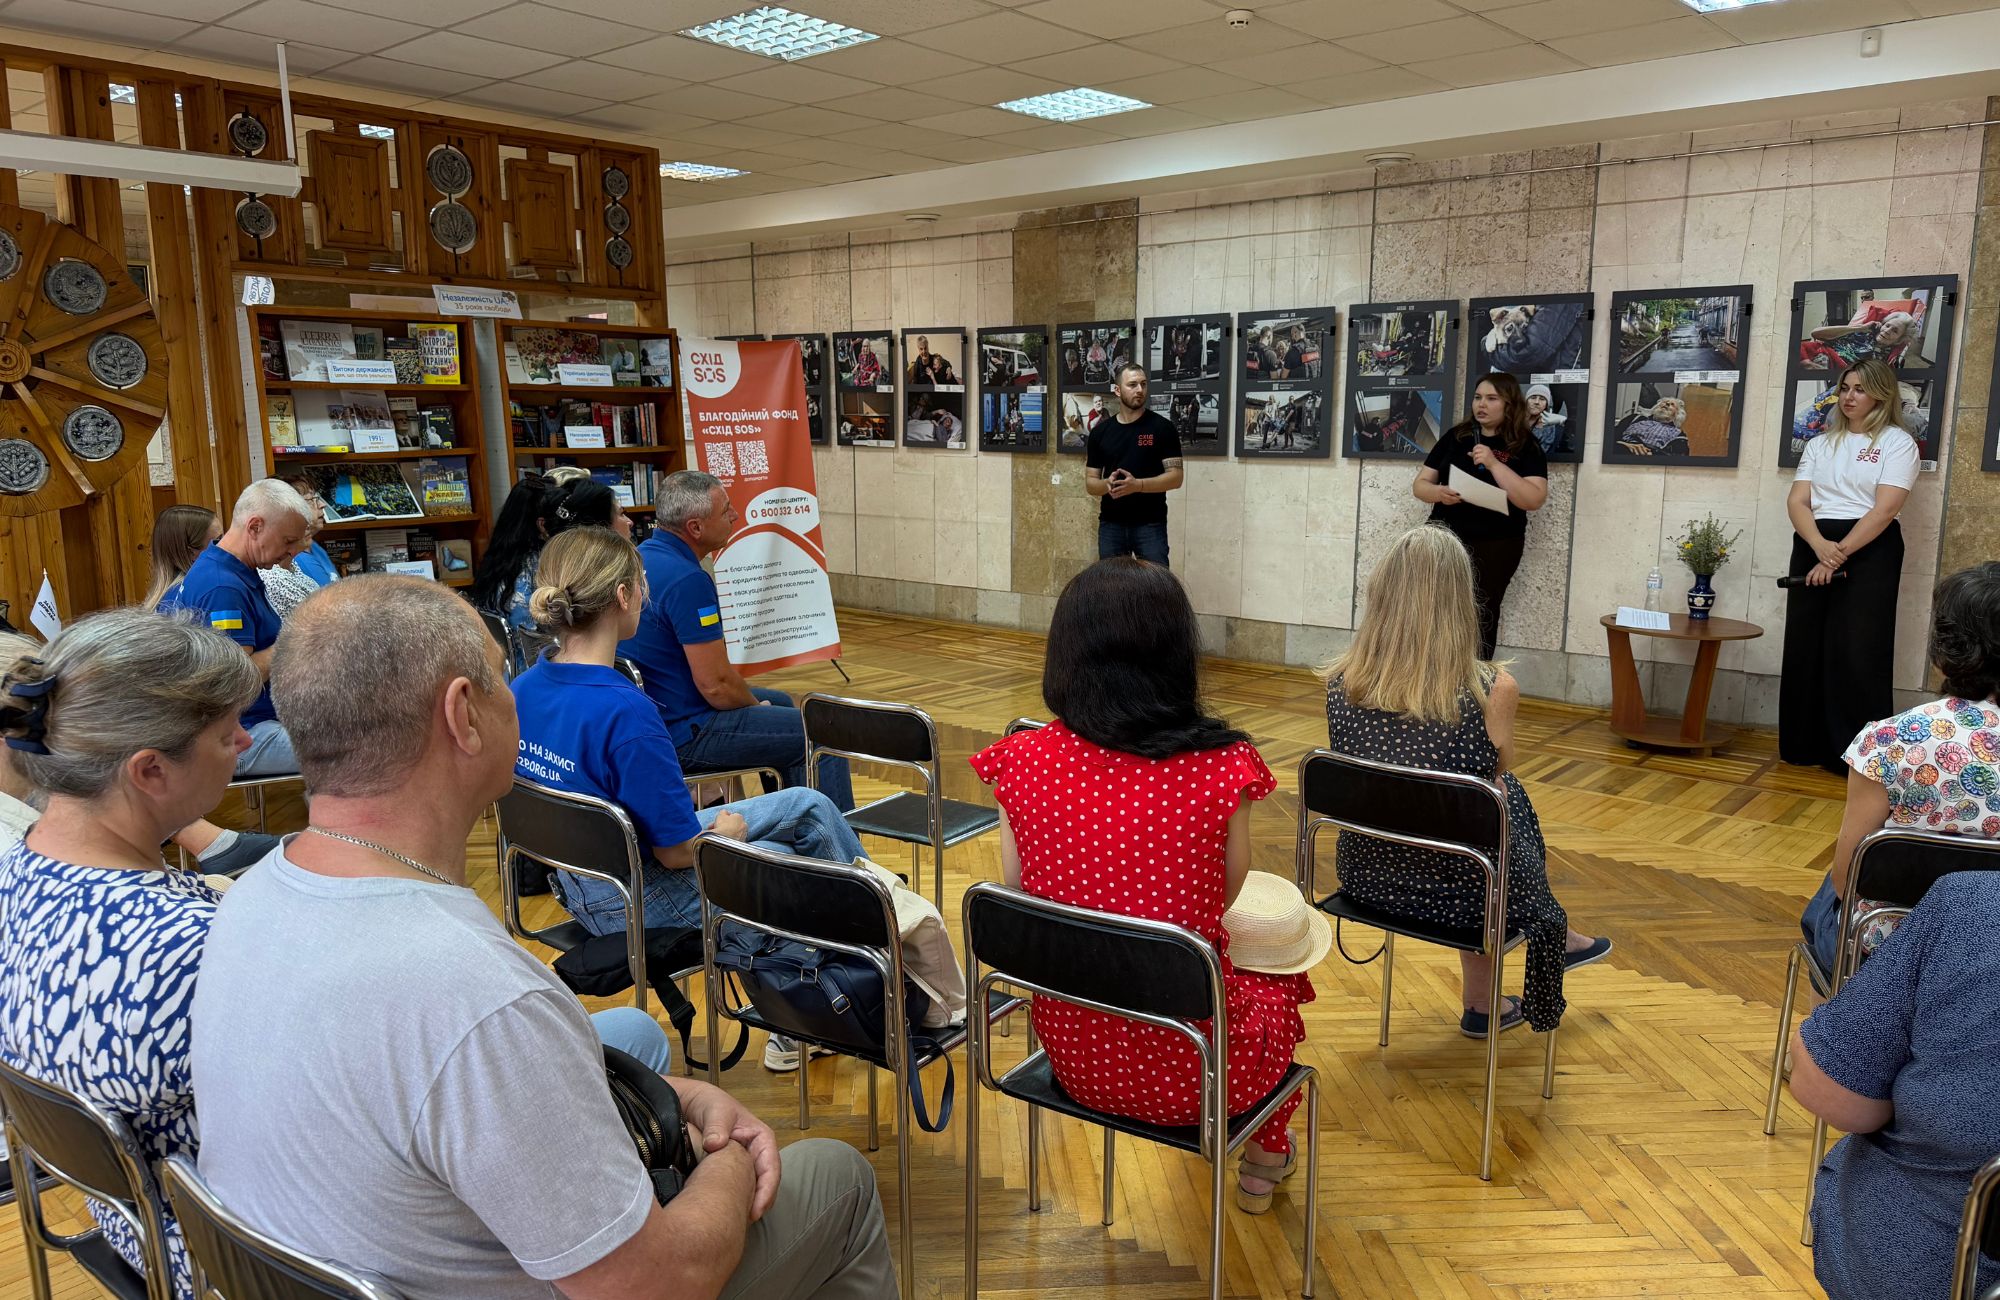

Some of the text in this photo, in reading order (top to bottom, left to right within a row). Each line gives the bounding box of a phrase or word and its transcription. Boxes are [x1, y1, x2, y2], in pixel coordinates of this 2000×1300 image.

[442, 294, 492, 304] Незалежність
[420, 348, 458, 356] ЗАЛЕЖНОСТІ
[690, 352, 724, 366] СХІД
[693, 368, 726, 383] SOS
[699, 408, 799, 423] БЛАГОДІЙНИЙ ФОНД
[702, 425, 762, 437] «СХІД SOS»
[1856, 455, 1879, 463] SOS
[750, 510, 758, 518] 0
[761, 508, 778, 517] 800
[794, 505, 810, 514] 614
[529, 742, 542, 757] НА
[544, 748, 575, 773] ЗАХИСТ
[516, 756, 564, 783] 2P.ORG.UA
